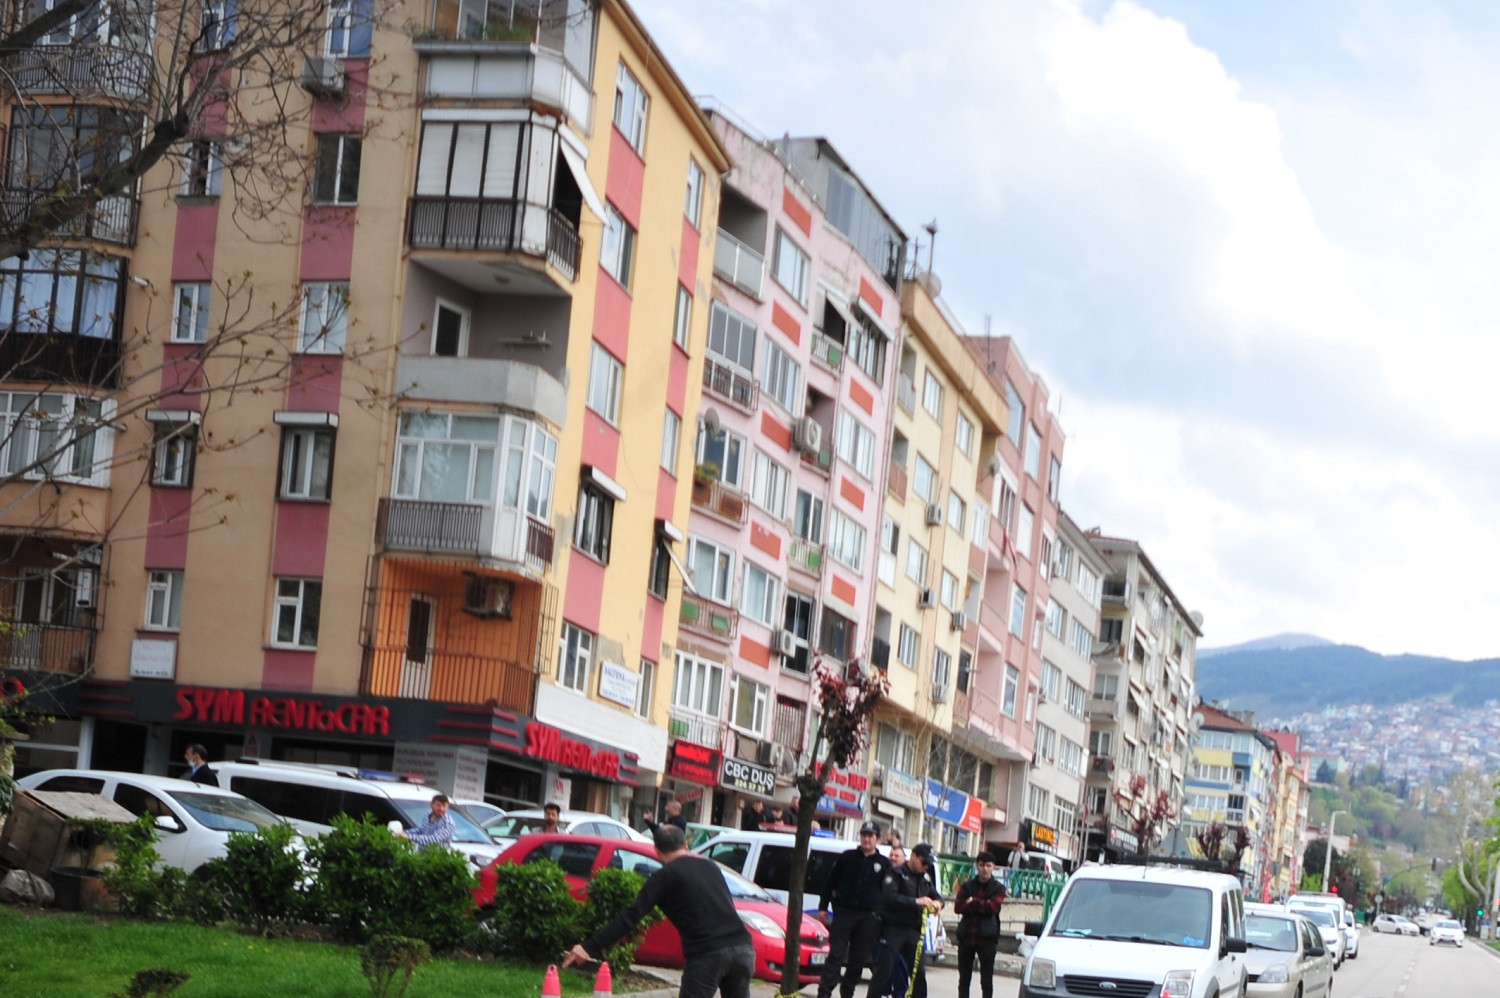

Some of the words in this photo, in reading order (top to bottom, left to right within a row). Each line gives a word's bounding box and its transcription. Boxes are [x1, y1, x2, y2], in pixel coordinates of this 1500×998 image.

[174, 687, 245, 725] SYM
[524, 722, 562, 763] SYM
[725, 760, 749, 780] CBC
